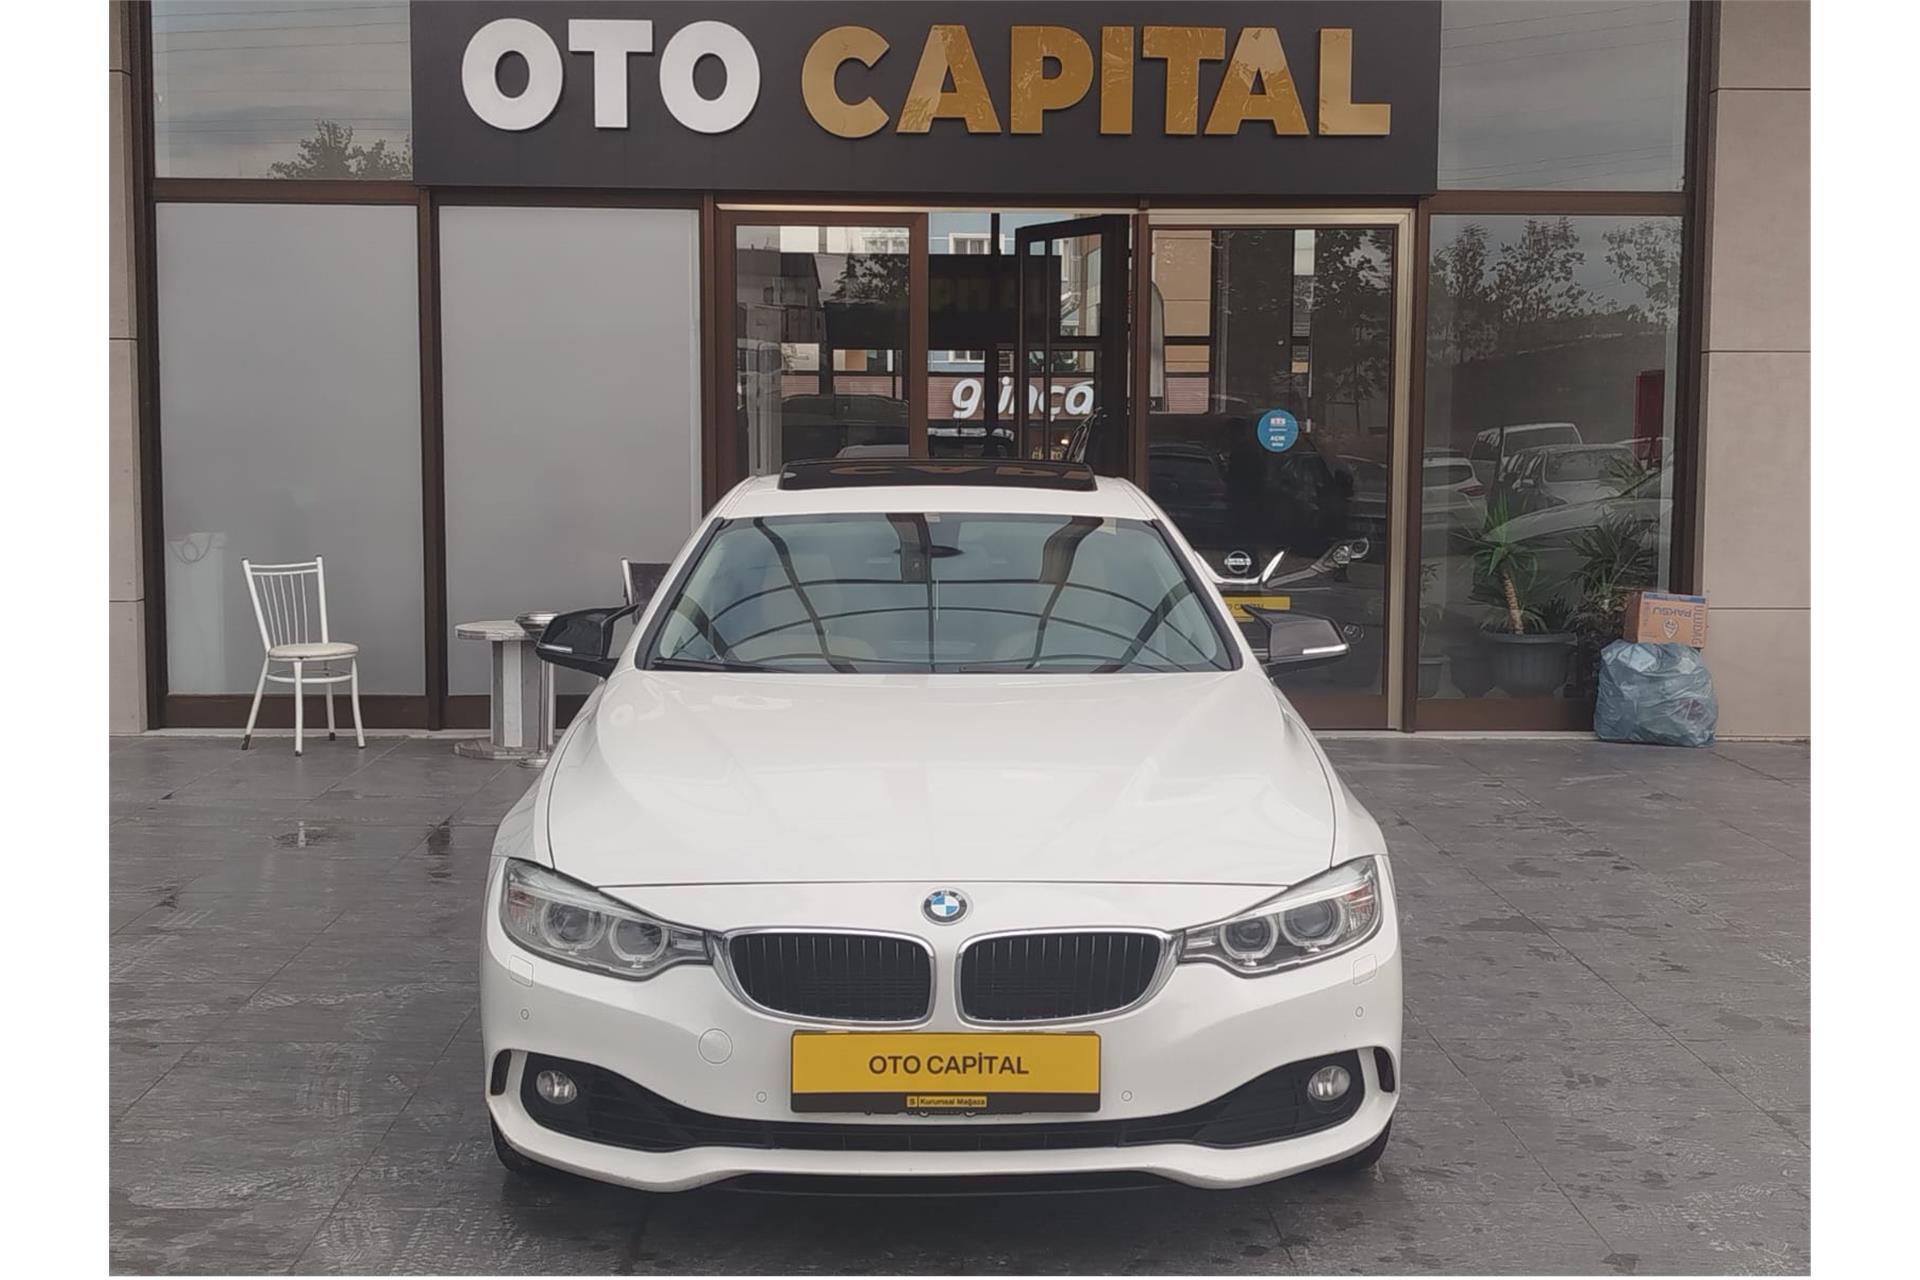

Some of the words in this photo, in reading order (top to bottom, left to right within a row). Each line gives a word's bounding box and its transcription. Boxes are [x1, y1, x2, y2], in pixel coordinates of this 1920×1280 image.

[461, 18, 761, 135] OTO
[801, 24, 1392, 138] CAPITAL
[869, 1055, 921, 1075] OTO
[927, 1052, 1029, 1075] CAPİTAL
[957, 1098, 985, 1107] Mağaza
